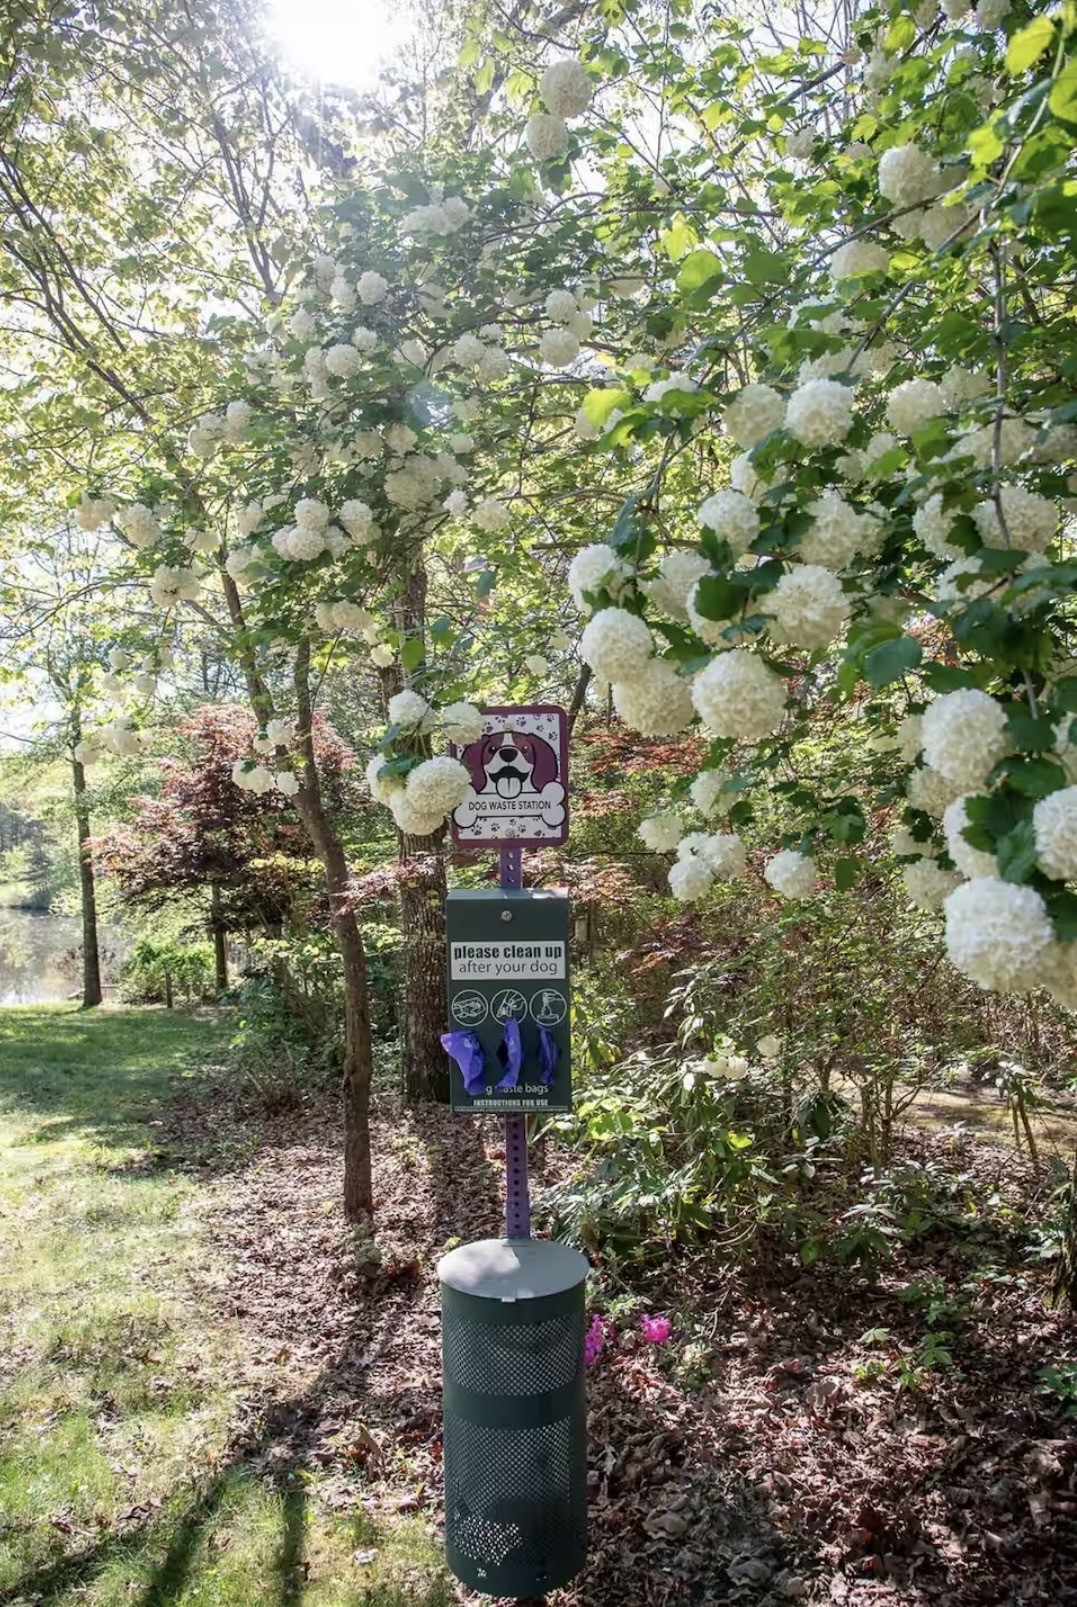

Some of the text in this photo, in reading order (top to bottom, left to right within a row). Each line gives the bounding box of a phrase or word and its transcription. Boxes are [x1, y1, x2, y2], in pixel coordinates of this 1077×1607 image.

[469, 801, 550, 810] DOG WASTE STATION
[454, 945, 562, 959] please clean up
[459, 960, 557, 976] after your dog
[524, 1083, 549, 1095] bags
